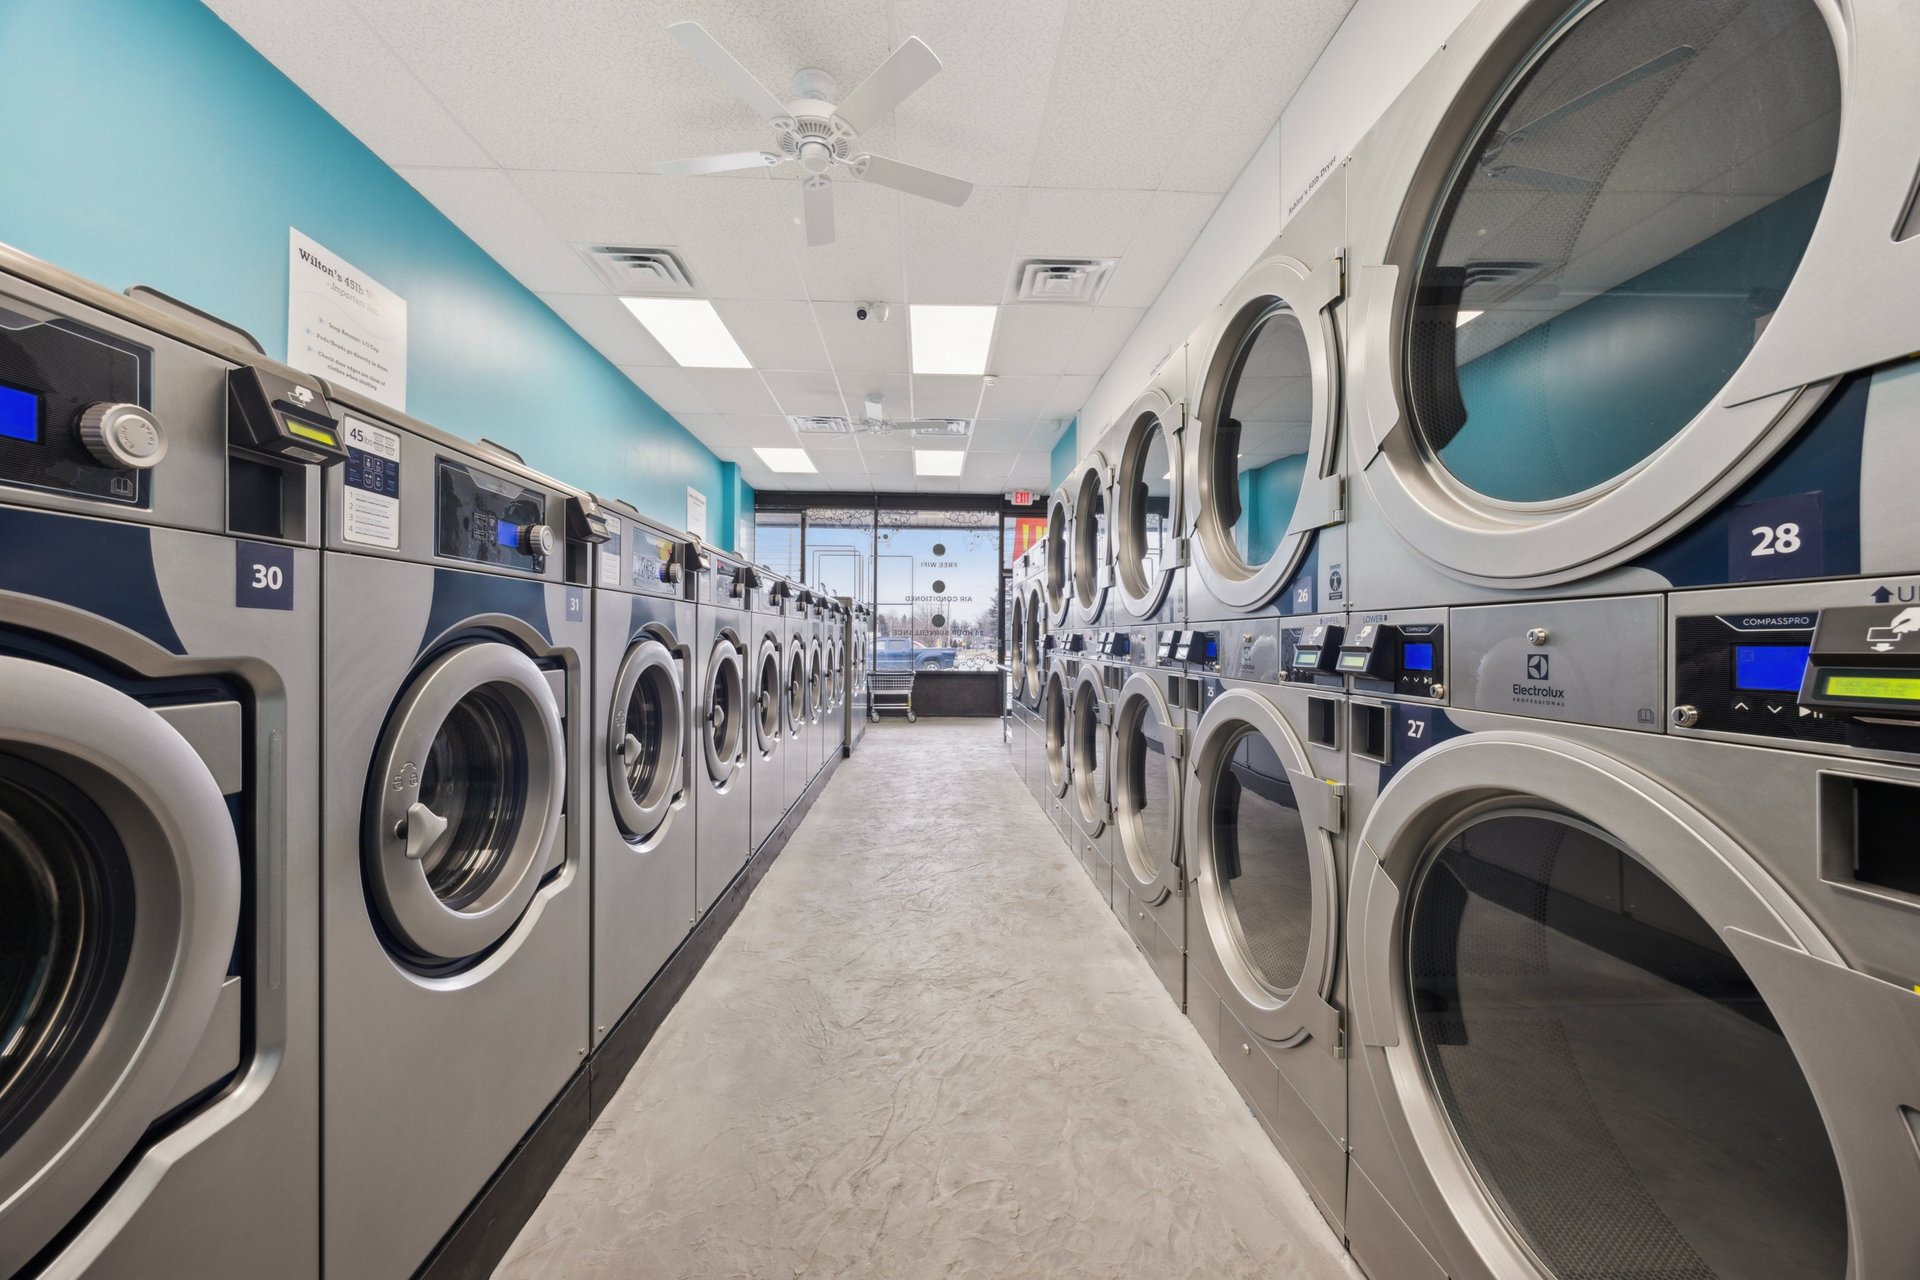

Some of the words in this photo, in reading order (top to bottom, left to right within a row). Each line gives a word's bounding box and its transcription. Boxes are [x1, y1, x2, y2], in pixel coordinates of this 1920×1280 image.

[298, 247, 342, 283] Wilton's
[344, 277, 364, 296] 45lb
[331, 282, 366, 308] Important
[1015, 491, 1030, 504] EXIT
[1751, 522, 1801, 556] 28
[252, 563, 283, 590] 30
[1297, 589, 1309, 603] 26
[570, 598, 579, 611] 31
[1362, 615, 1384, 624] LOWER
[1742, 616, 1810, 627] COMPASSPRO
[1207, 685, 1215, 698] 25
[1512, 683, 1565, 698] Electrolux
[1512, 698, 1565, 707] PROFESSIONAL
[1407, 719, 1425, 738] 27
